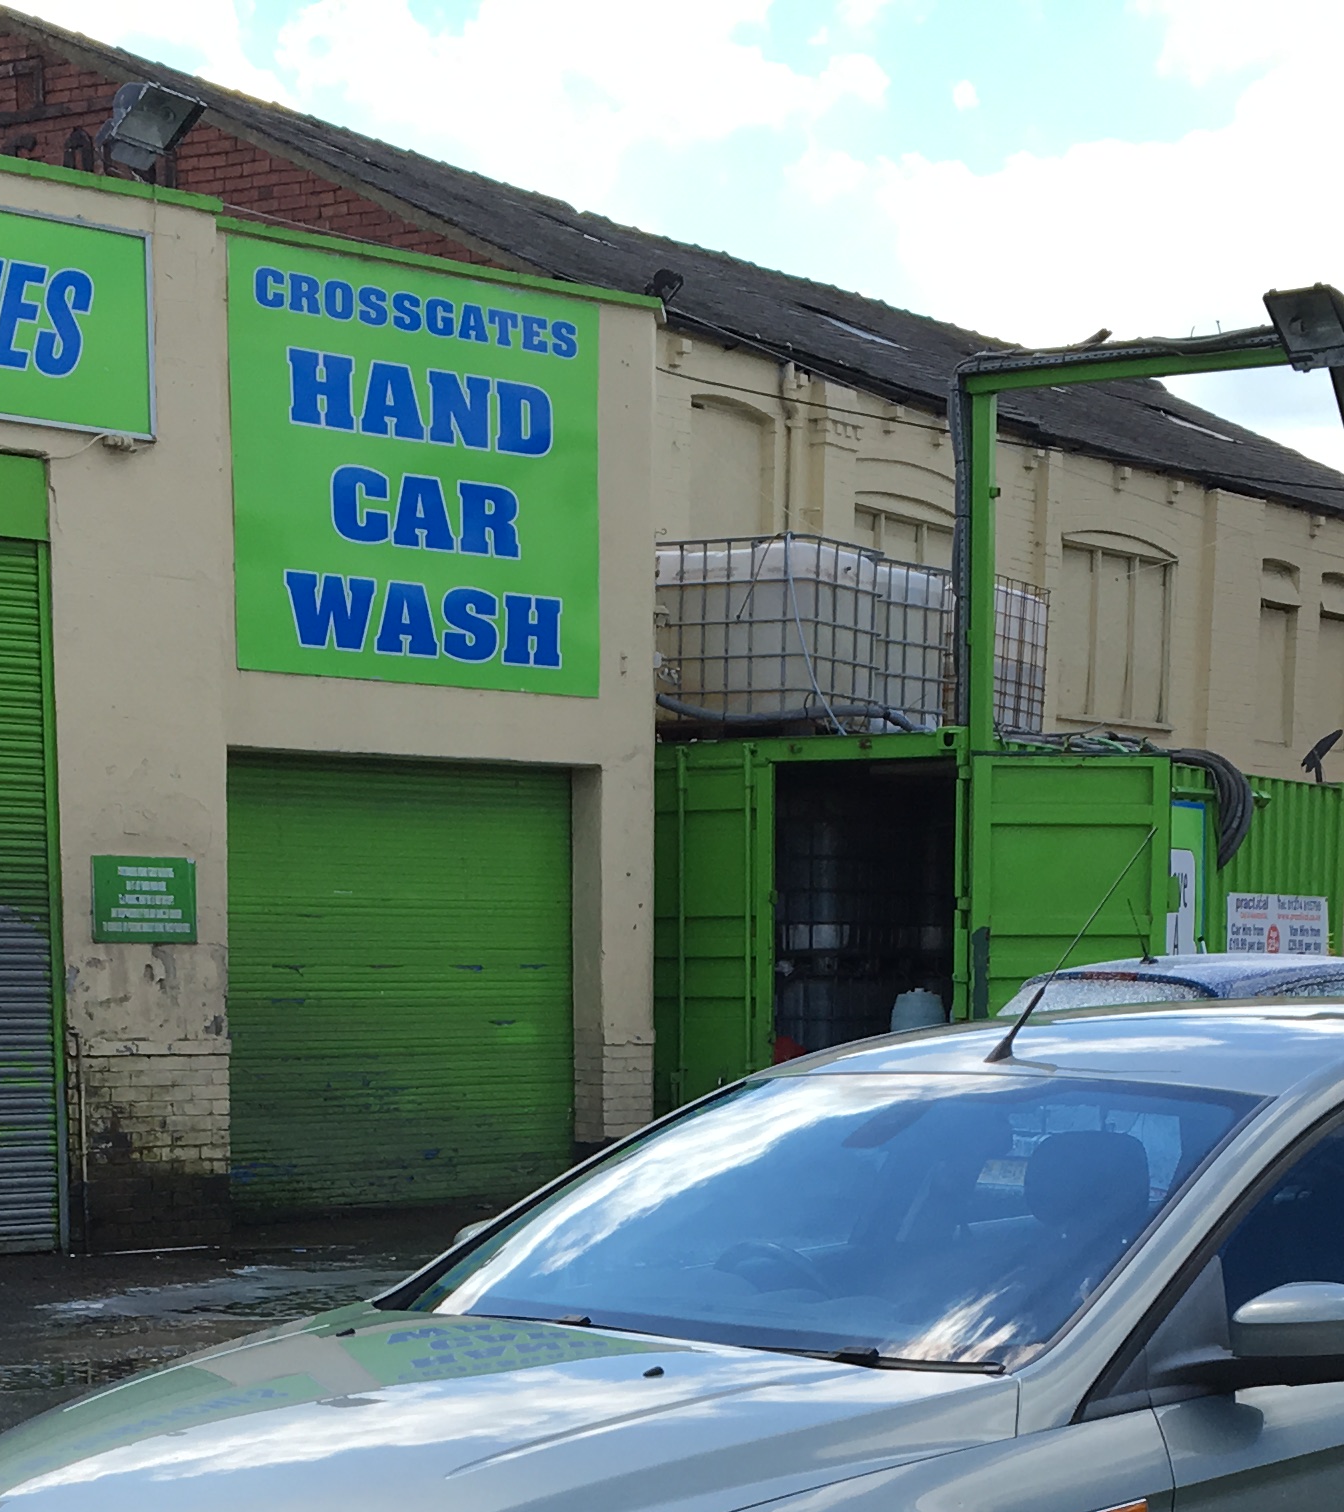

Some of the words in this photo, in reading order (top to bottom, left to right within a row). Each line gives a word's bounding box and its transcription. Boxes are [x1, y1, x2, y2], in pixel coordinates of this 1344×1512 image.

[254, 266, 579, 360] CROSSGATES
[286, 346, 554, 459] HAND
[331, 463, 521, 561] CAR
[283, 569, 563, 670] WASH
